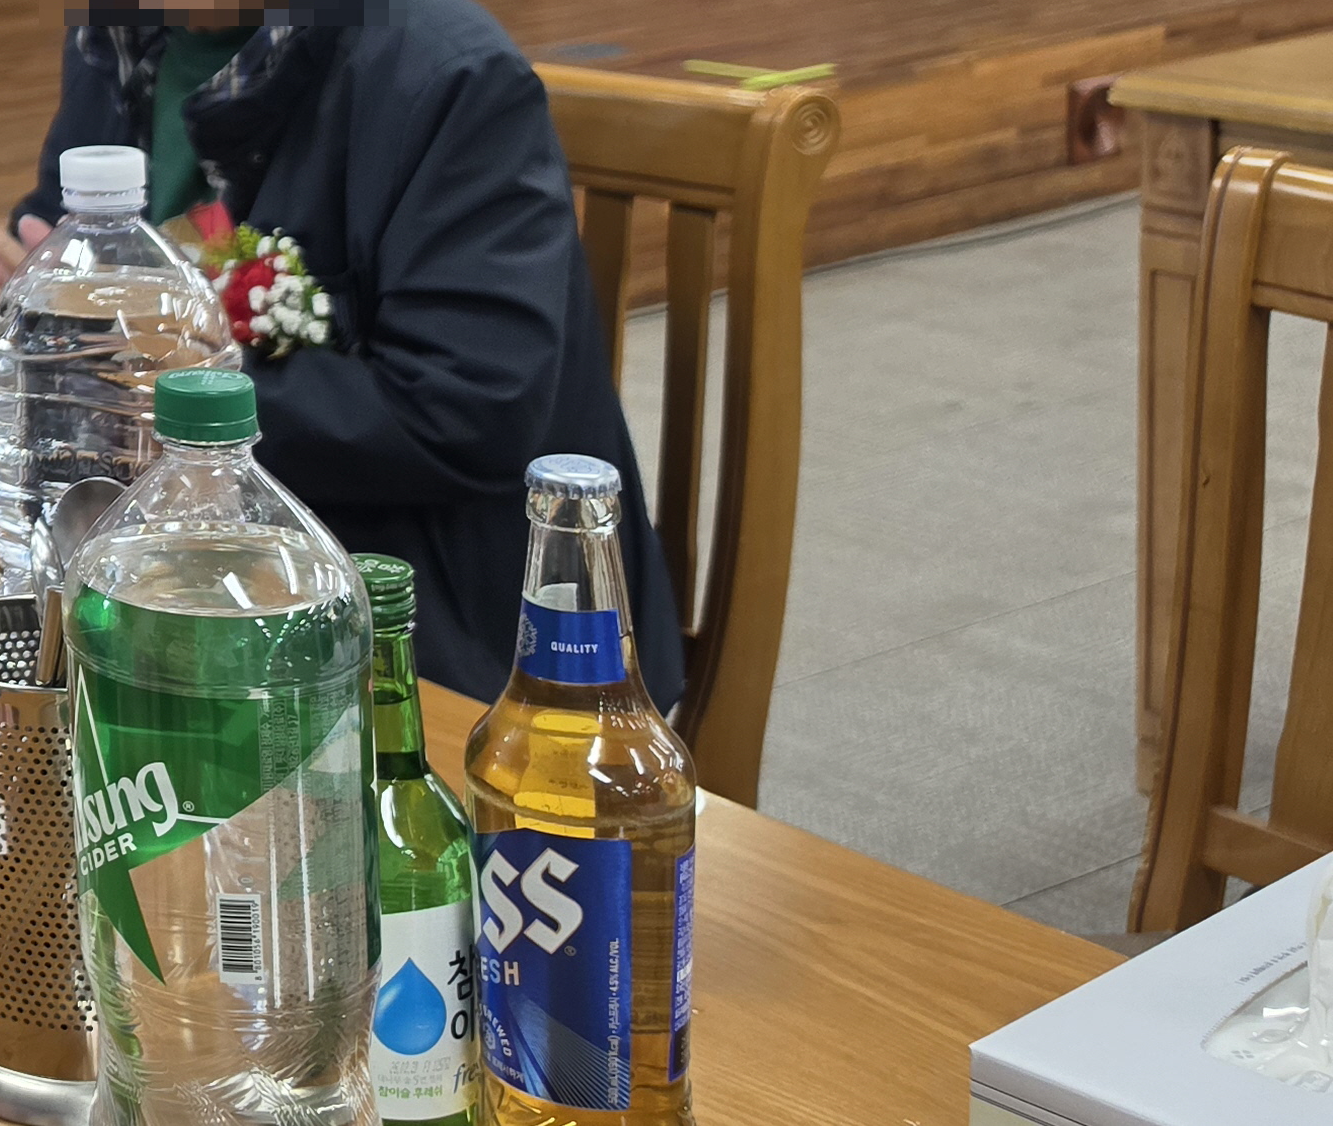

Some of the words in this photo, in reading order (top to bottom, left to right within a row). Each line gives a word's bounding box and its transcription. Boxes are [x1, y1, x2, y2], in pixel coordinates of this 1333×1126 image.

[550, 640, 599, 654] QUALITY
[79, 832, 138, 876] CIDER
[480, 847, 584, 955] SS
[480, 956, 520, 986] ESH
